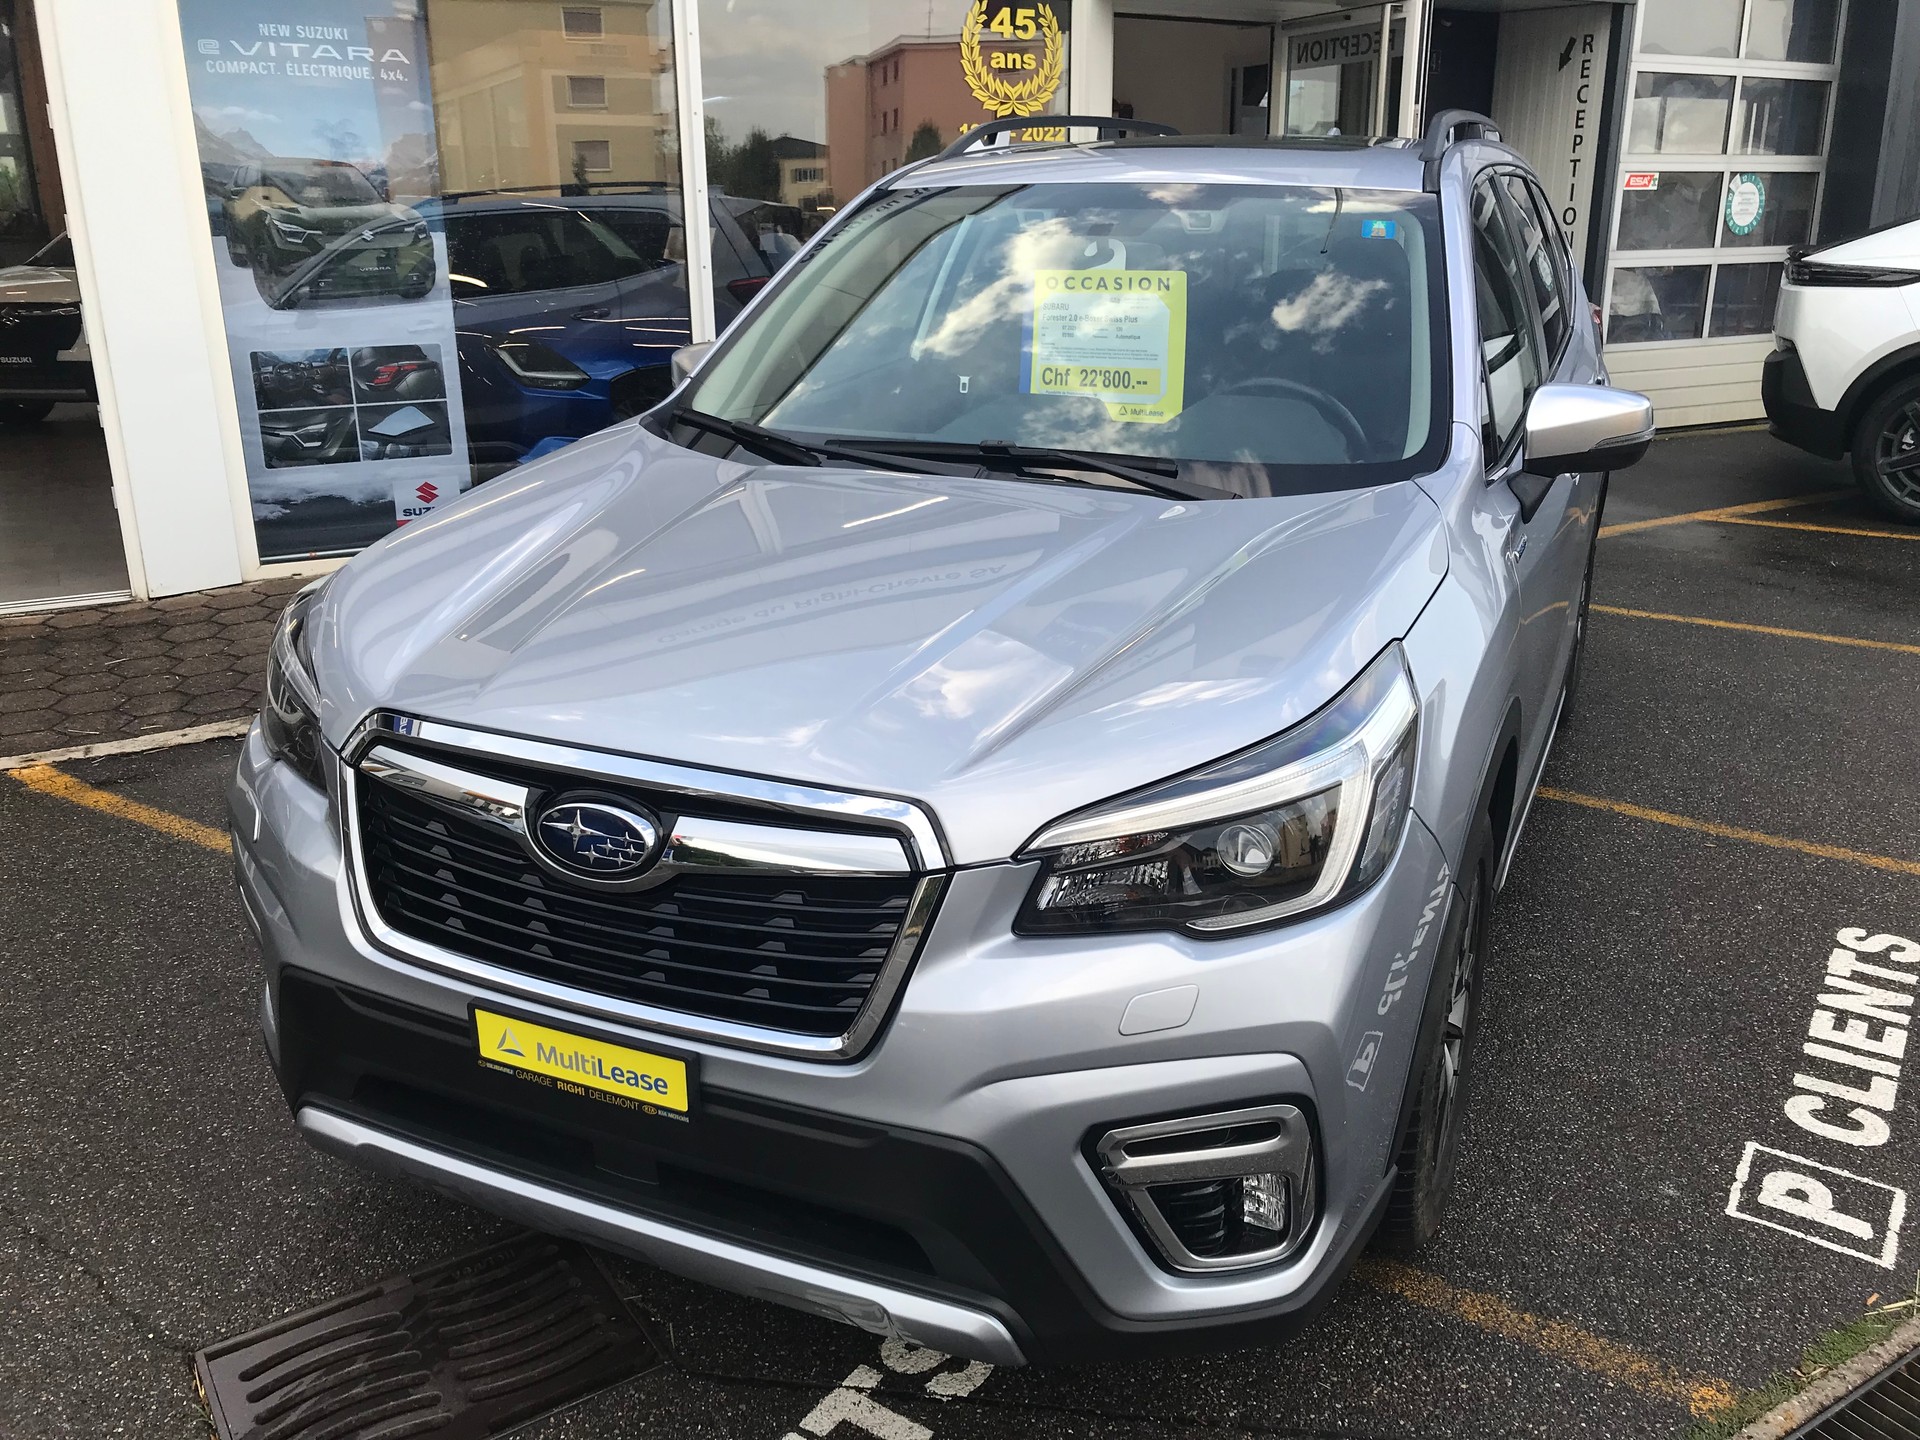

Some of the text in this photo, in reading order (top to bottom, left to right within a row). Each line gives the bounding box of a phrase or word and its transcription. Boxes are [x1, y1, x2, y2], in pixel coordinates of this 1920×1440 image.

[258, 23, 348, 40] NEW SUZUKI
[990, 7, 1037, 40] 45
[230, 40, 410, 64] VITARA
[990, 52, 1037, 69] ans
[206, 60, 409, 81] COMPACT. ÉLECTRIQUE. 4x4.
[1021, 127, 1066, 142] 2022
[1046, 276, 1171, 292] OCCASION
[1043, 303, 1070, 311] SUBARU
[1042, 314, 1067, 322] Forester
[1068, 314, 1078, 322] 2.0
[1042, 367, 1071, 386] Chf
[1129, 407, 1164, 417] MultiLease
[1784, 926, 1920, 1147] CLIENTS
[536, 1041, 669, 1095] MultiLease
[515, 1069, 553, 1087] GARAGE
[556, 1080, 586, 1096] RIGHI
[588, 1089, 640, 1111] DELEMONT
[1757, 1170, 1874, 1240] P
